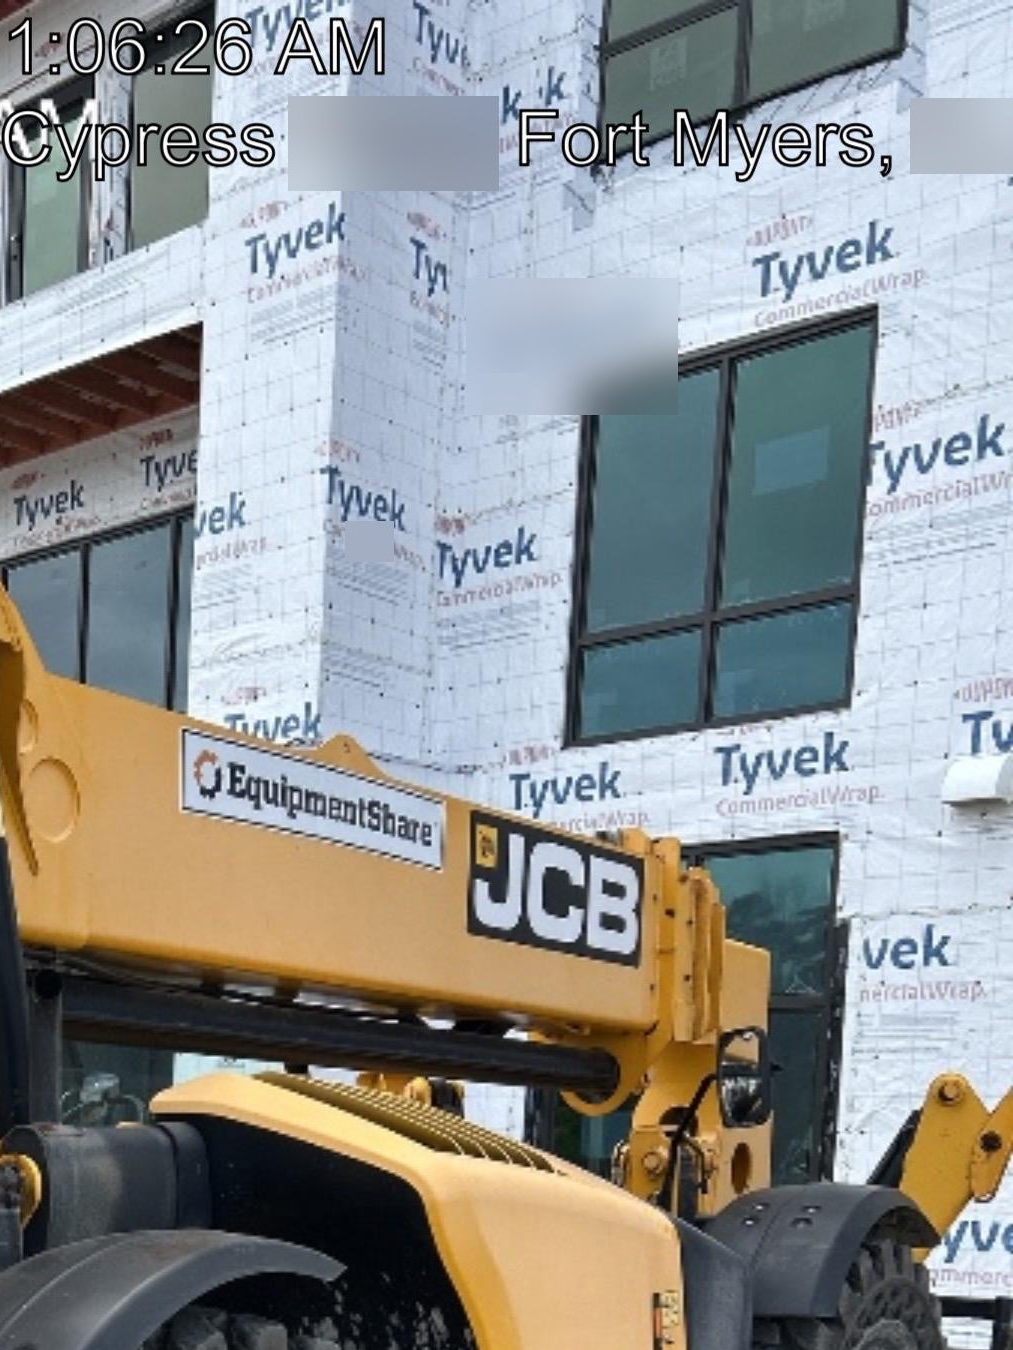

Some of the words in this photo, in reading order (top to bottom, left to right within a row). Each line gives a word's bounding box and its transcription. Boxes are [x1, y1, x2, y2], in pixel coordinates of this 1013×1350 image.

[244, 200, 346, 279] Tyvek
[752, 219, 895, 303] Tyvek
[869, 414, 1005, 495] Tyvek
[13, 479, 84, 532] Tyvek
[320, 464, 406, 532] Tyvek
[436, 526, 538, 588] Tyvek
[509, 762, 621, 818] Tyvek
[714, 731, 849, 795] Tyvek
[227, 761, 434, 847] EquipmentShare
[715, 784, 881, 817] CommercialWrap
[473, 833, 641, 955] JCB
[863, 923, 951, 970] vek
